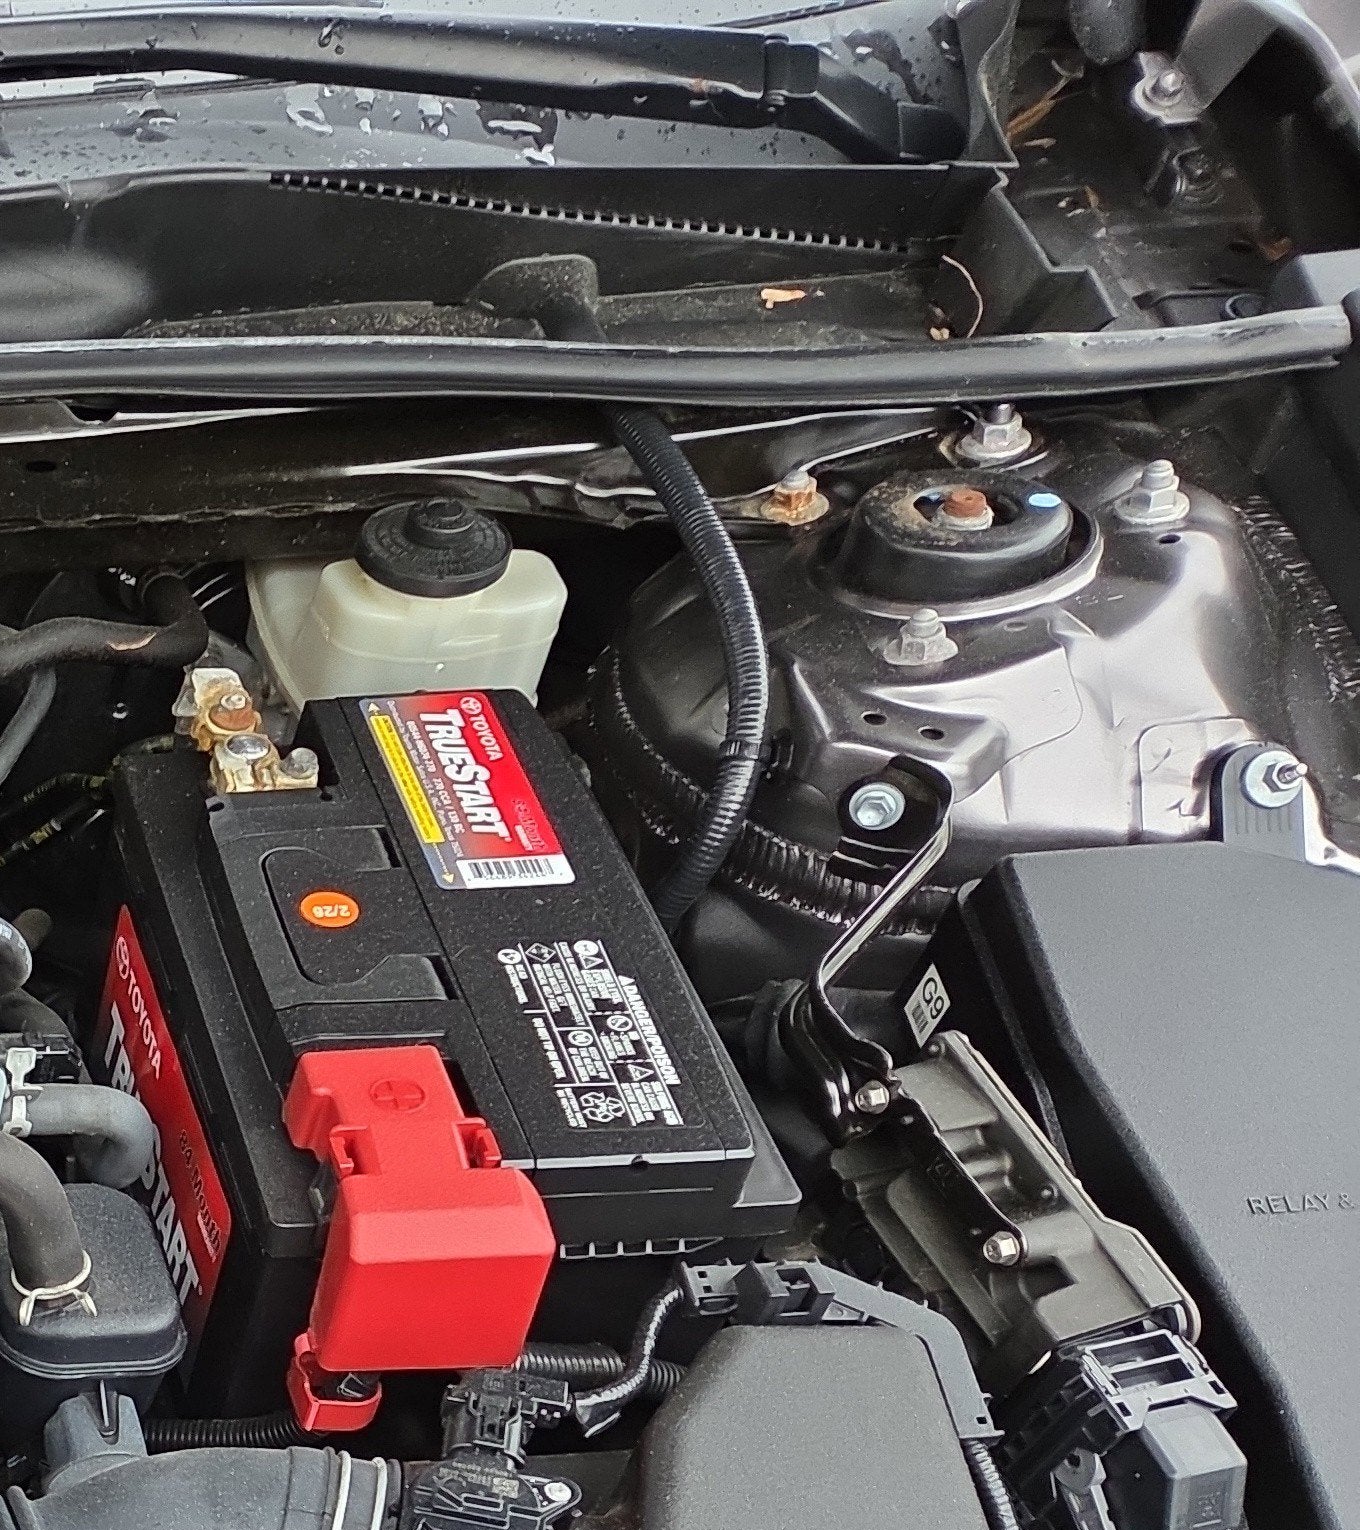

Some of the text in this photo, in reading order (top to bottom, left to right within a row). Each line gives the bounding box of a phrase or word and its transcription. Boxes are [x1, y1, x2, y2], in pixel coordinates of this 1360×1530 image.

[470, 714, 504, 761] TOYOTA
[922, 977, 945, 1020] G9
[125, 968, 162, 1080] TOYOTA
[623, 987, 681, 1085] DANGER/POISON
[1245, 1192, 1355, 1216] RELAY &
